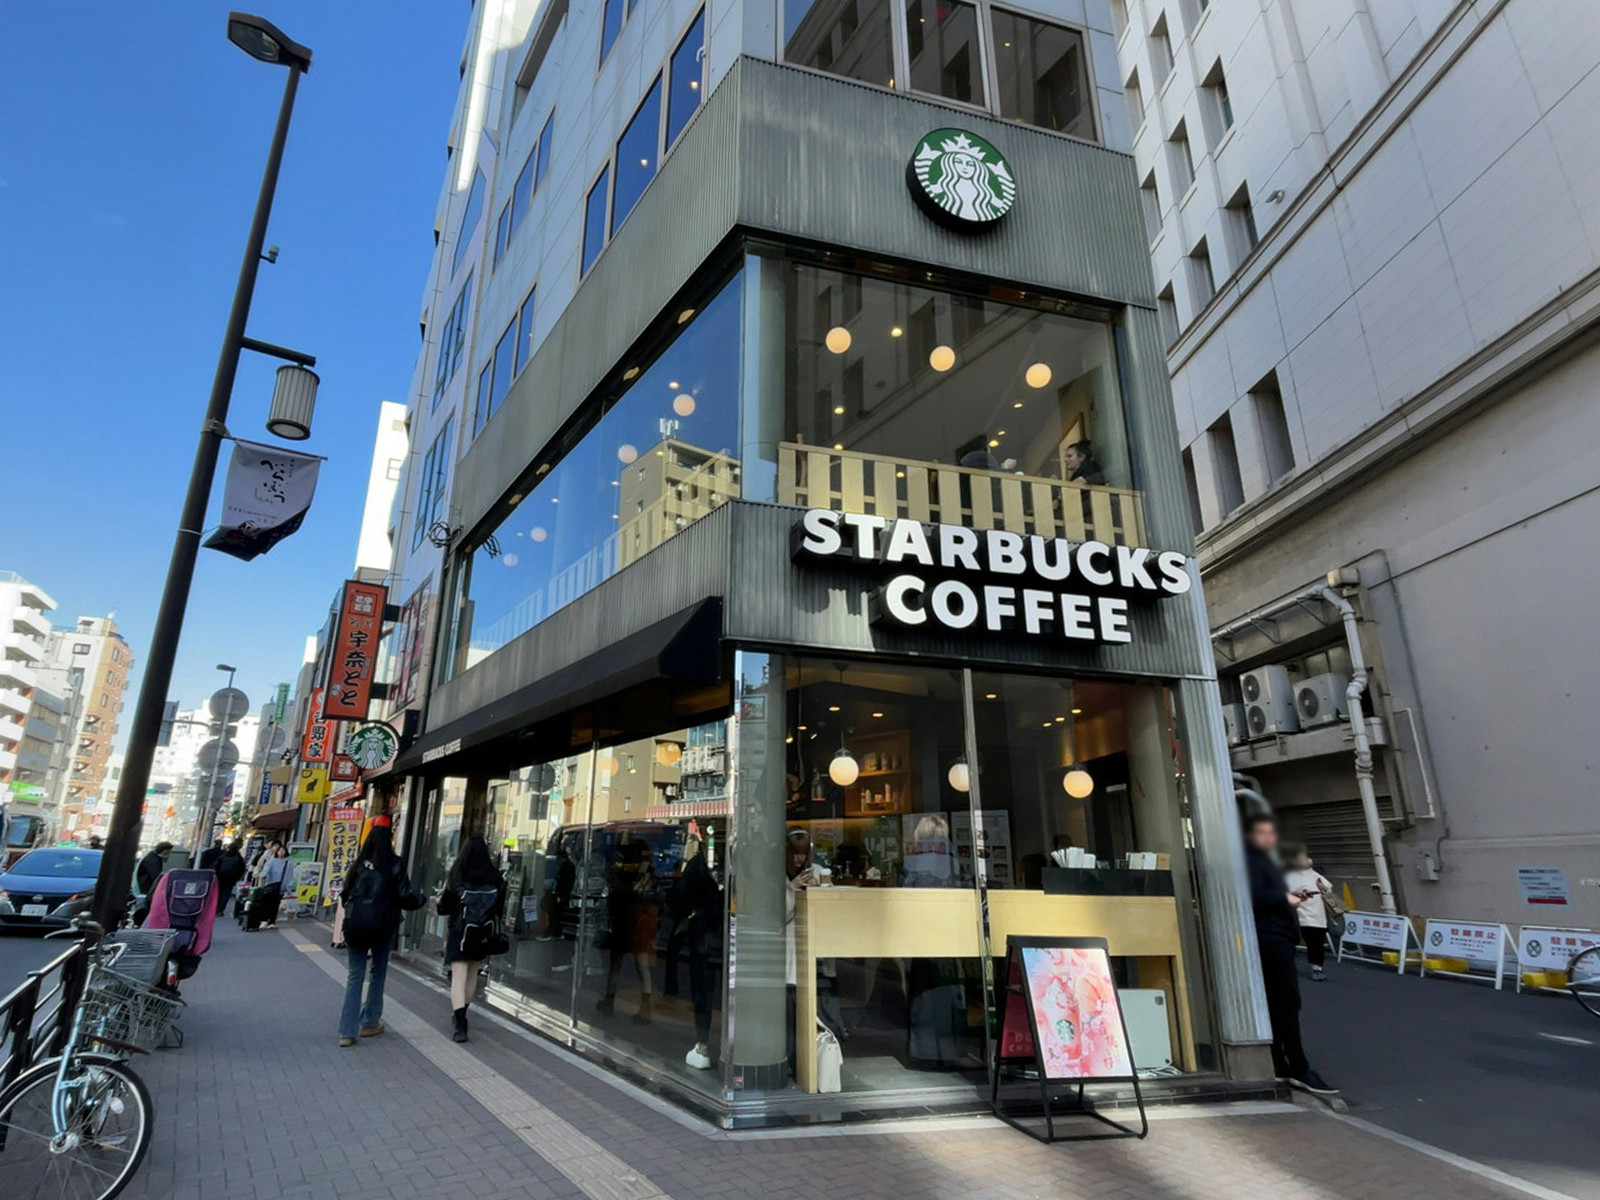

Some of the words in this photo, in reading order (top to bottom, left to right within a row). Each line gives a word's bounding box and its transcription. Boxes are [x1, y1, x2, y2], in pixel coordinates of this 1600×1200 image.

[803, 508, 1192, 594] STARBUCKS
[886, 575, 1132, 643] COFFEE
[340, 630, 369, 707] 宇奈とと
